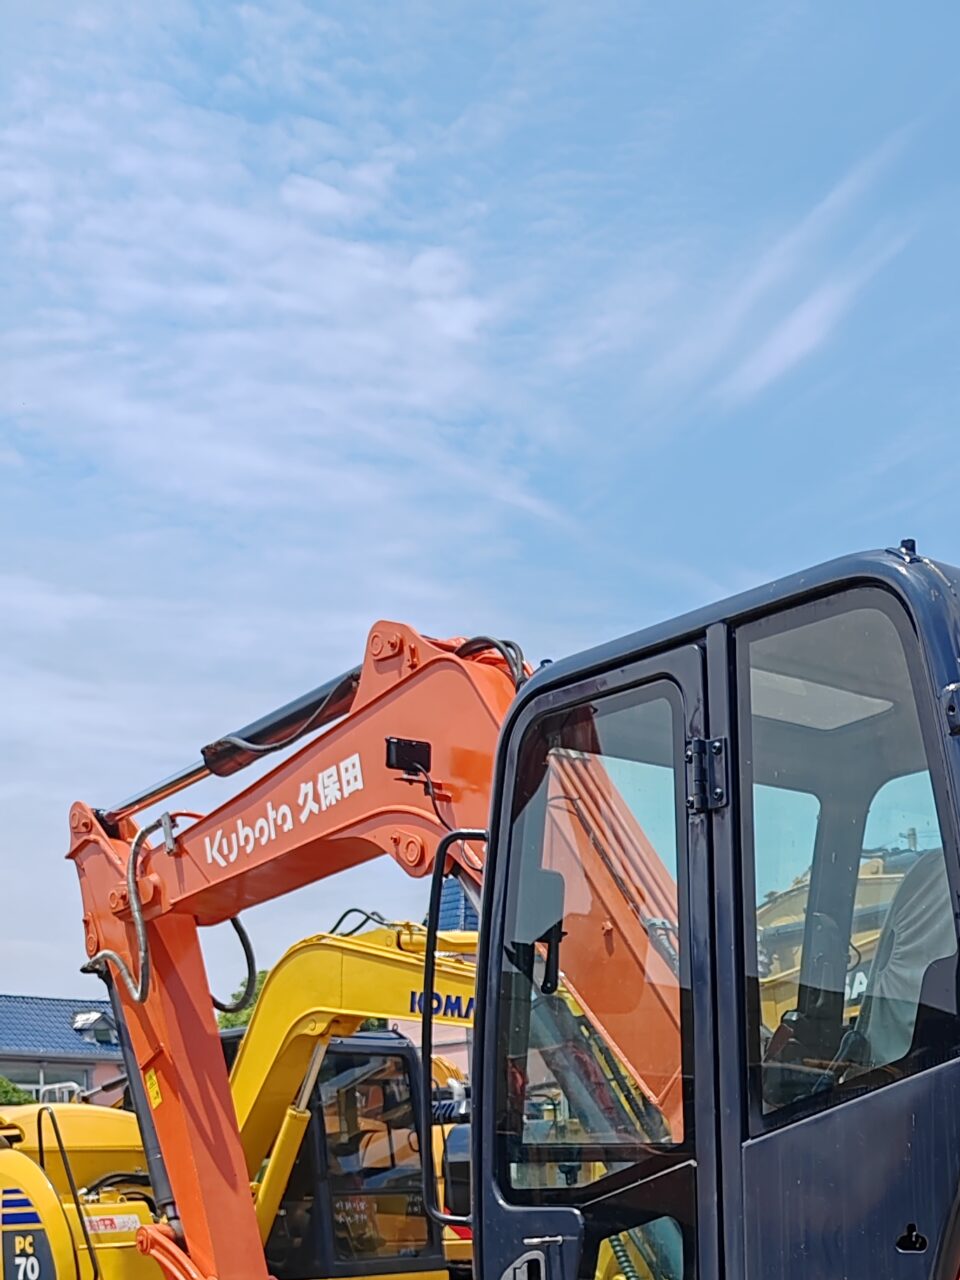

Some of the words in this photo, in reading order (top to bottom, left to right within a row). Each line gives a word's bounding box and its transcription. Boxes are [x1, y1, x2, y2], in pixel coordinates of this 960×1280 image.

[204, 801, 294, 868] Kubota
[297, 752, 364, 824] 久保田
[14, 1234, 34, 1255] PC
